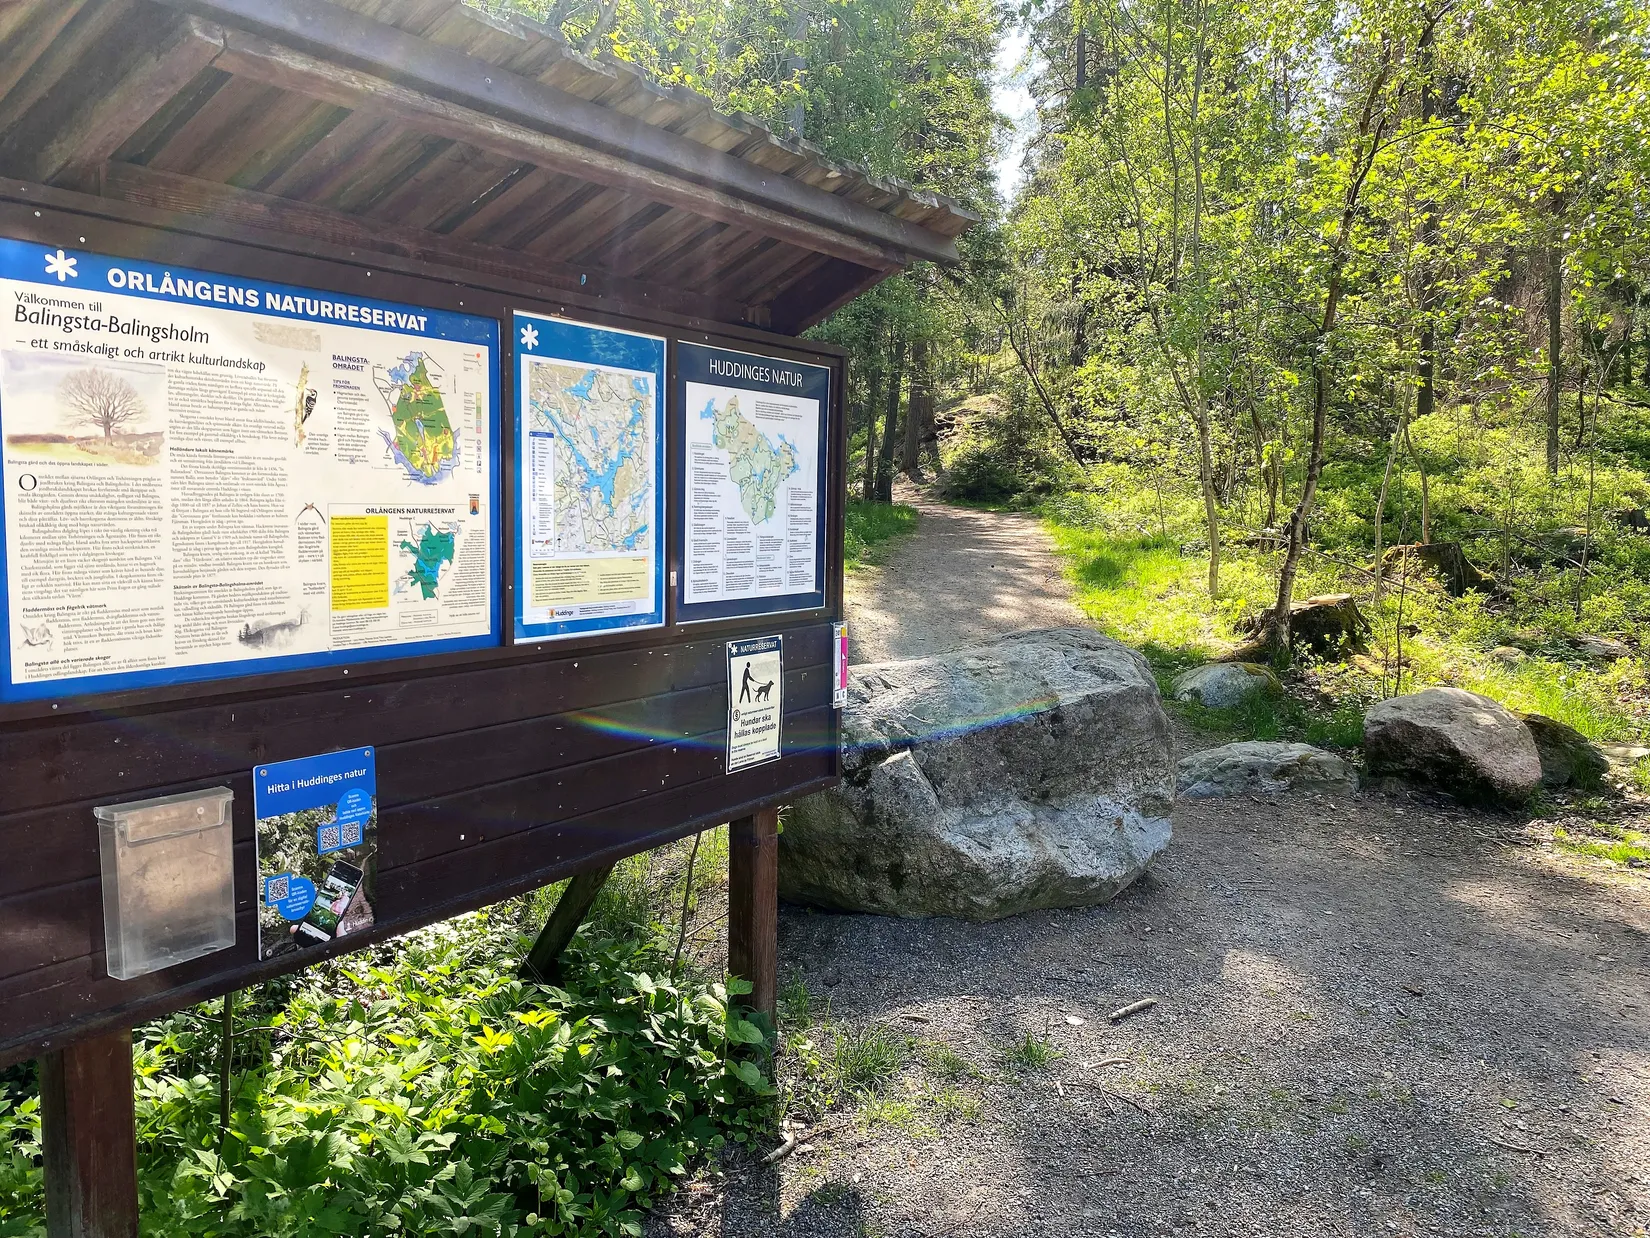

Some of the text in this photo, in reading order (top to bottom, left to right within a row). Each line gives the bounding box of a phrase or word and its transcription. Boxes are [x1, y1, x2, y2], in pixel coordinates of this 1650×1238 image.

[14, 291, 102, 312] Välkommen till
[107, 268, 428, 332] ORLÅNGENS NATURRESERVAT
[15, 304, 209, 344] Balingsta-Balingsholm
[31, 338, 48, 349] ett
[53, 340, 120, 359] småskaligt
[124, 347, 144, 358] och
[149, 351, 185, 362] artrikt
[188, 353, 266, 373] kulturlandskap
[710, 358, 803, 388] HUDDINGES NATUR
[741, 717, 761, 727] Hundar
[267, 768, 367, 794] Hitta i Huddinges natur
